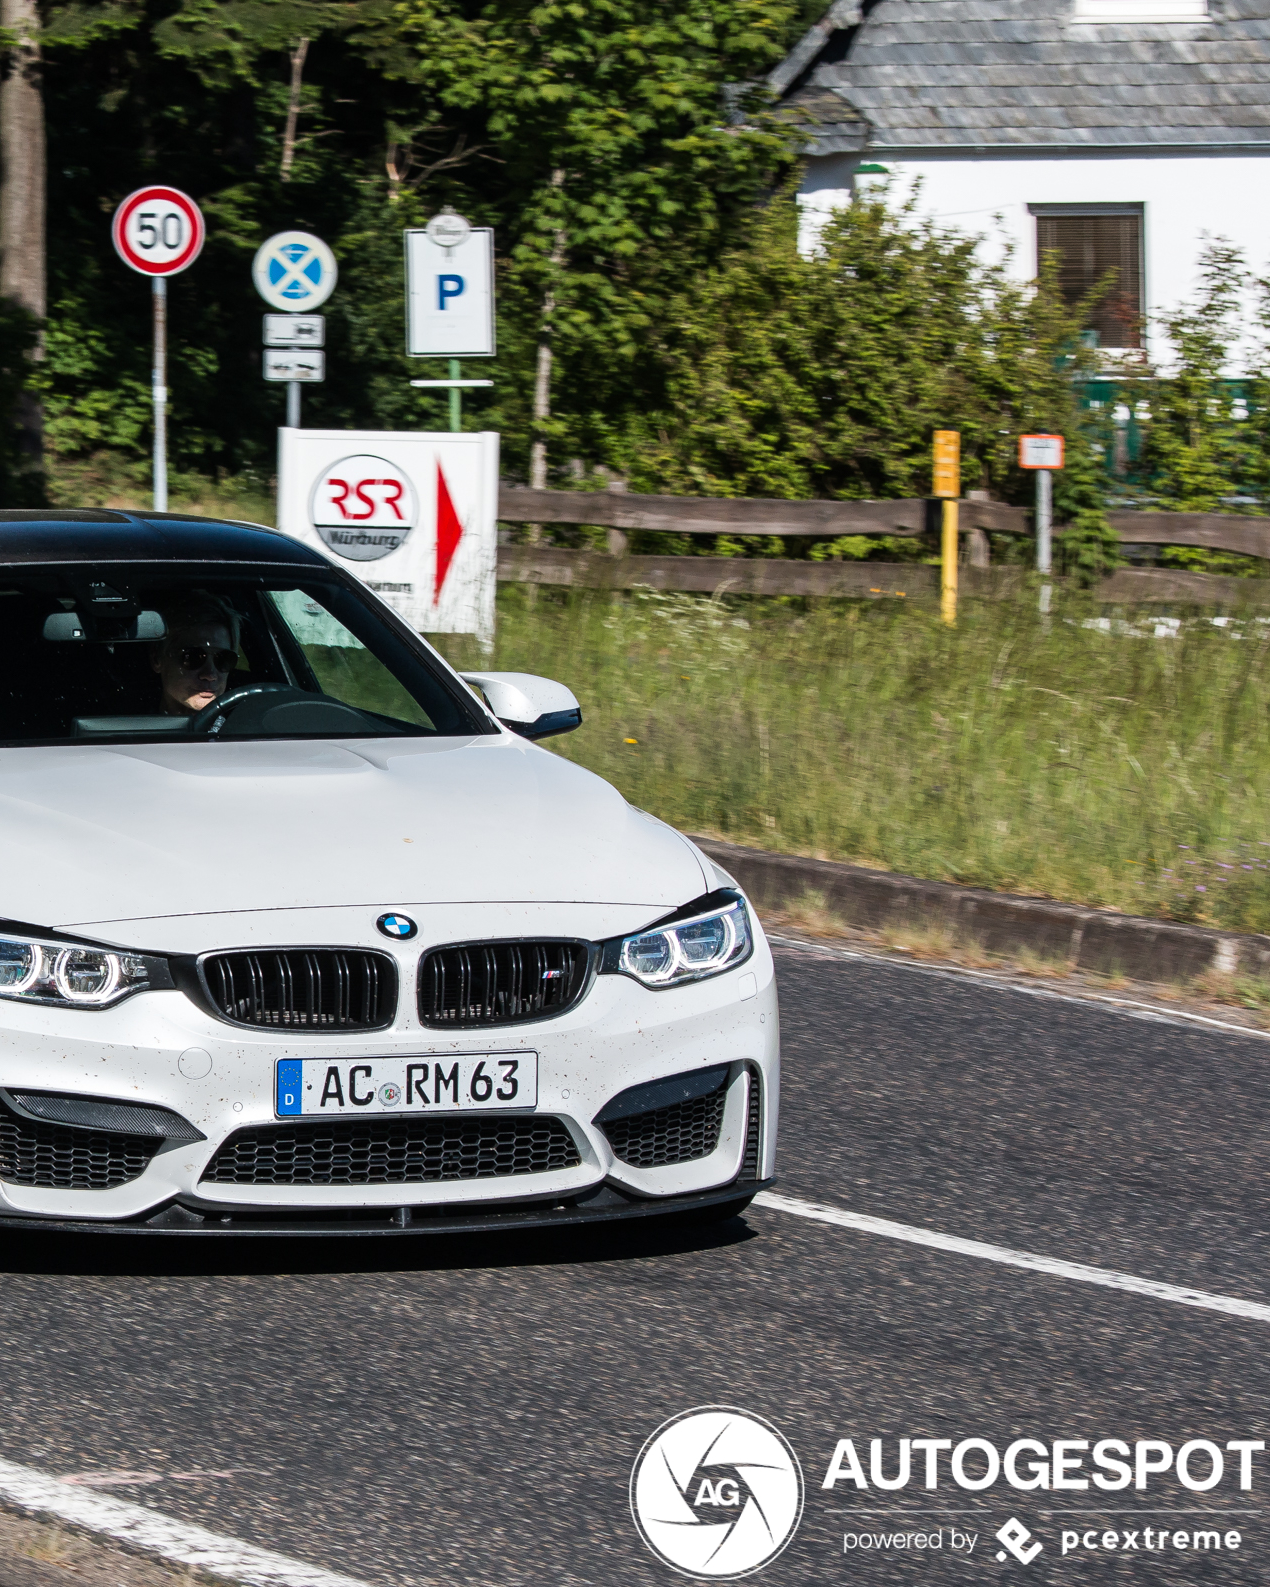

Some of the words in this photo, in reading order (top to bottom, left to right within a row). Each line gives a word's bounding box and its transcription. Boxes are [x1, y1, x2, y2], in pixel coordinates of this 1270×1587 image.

[137, 212, 183, 250] 50
[436, 273, 466, 311] P
[327, 478, 405, 520] RSR
[284, 1093, 294, 1106] D
[320, 1064, 375, 1108] AC
[406, 1061, 460, 1105] RM
[470, 1059, 519, 1103] 63
